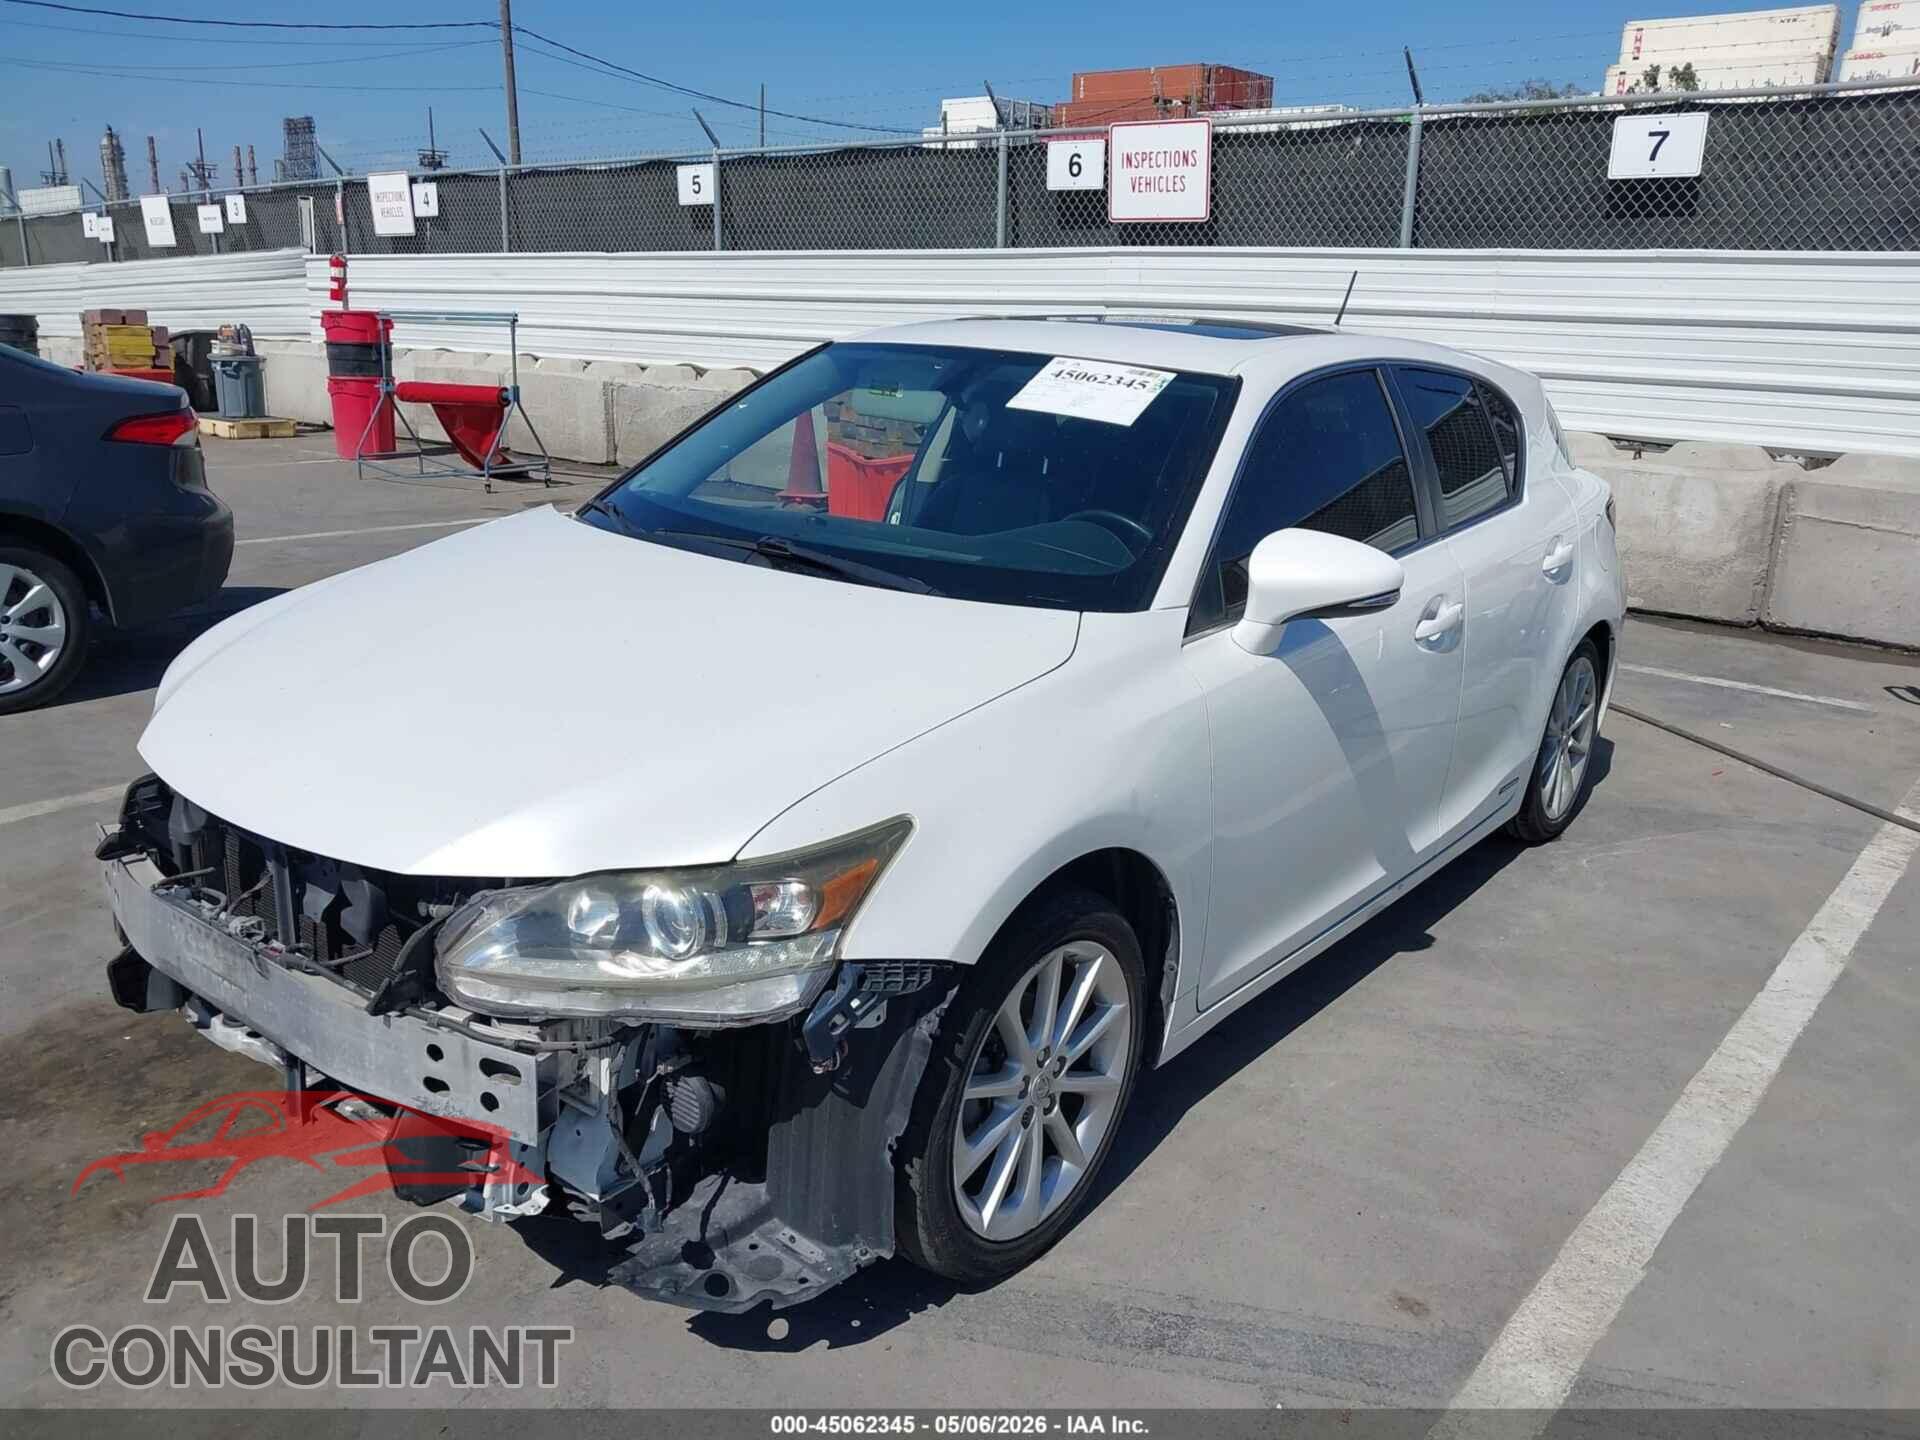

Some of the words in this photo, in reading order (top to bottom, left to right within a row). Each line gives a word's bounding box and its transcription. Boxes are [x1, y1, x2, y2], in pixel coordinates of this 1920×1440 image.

[1648, 130, 1670, 161] 7
[1068, 153, 1082, 177] 6
[1121, 150, 1198, 169] INSPECTIONS
[692, 174, 702, 194] 5
[1130, 175, 1186, 193] VEHICLES
[423, 191, 430, 208] 4
[233, 202, 240, 217] 3
[1051, 368, 1150, 390] 45062345
